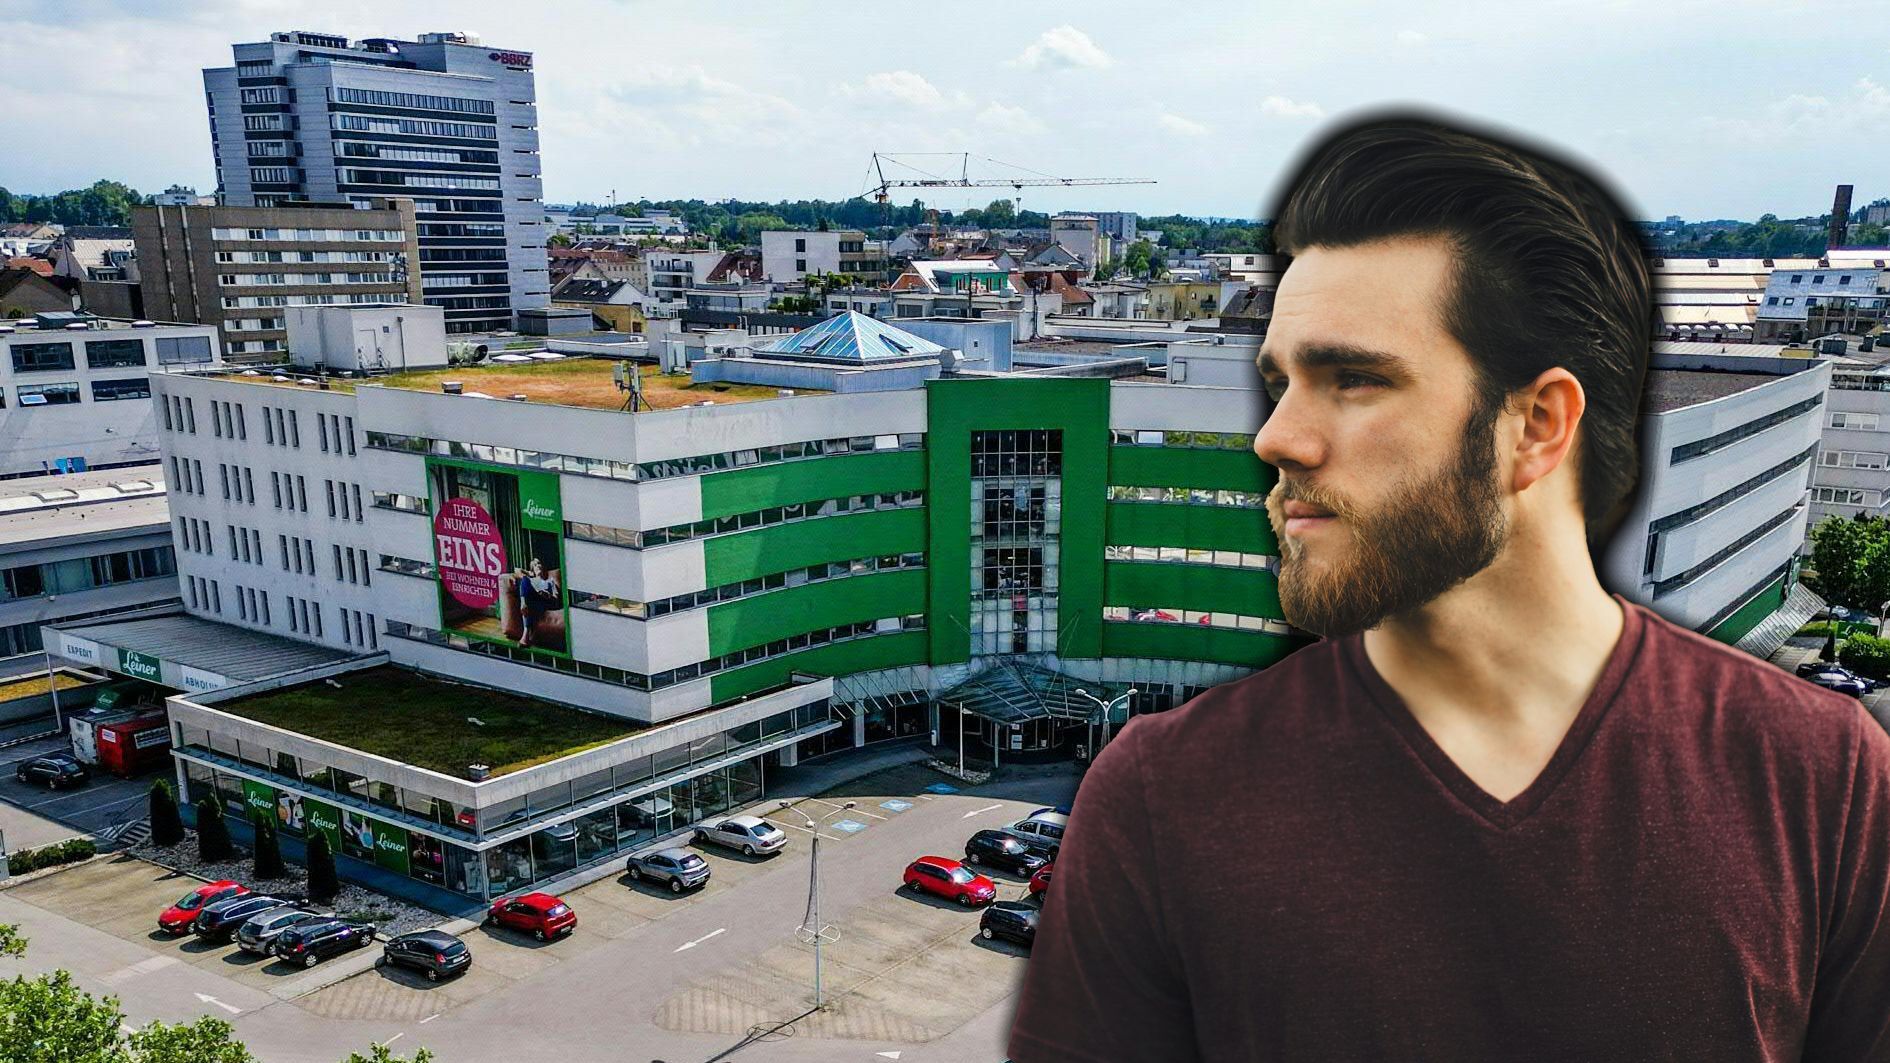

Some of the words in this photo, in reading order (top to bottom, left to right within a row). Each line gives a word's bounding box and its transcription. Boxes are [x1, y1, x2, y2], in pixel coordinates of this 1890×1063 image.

[453, 504, 477, 519] IHRE
[523, 499, 555, 517] Leiner
[443, 517, 490, 535] NUMMER
[437, 534, 501, 576] EINS
[457, 573, 490, 587] WOHNEN
[67, 644, 93, 659] EXPEDIT
[123, 651, 157, 676] Leiner
[248, 791, 273, 808] Leiner
[310, 811, 337, 830] Leiner
[376, 833, 405, 852] Leiner
